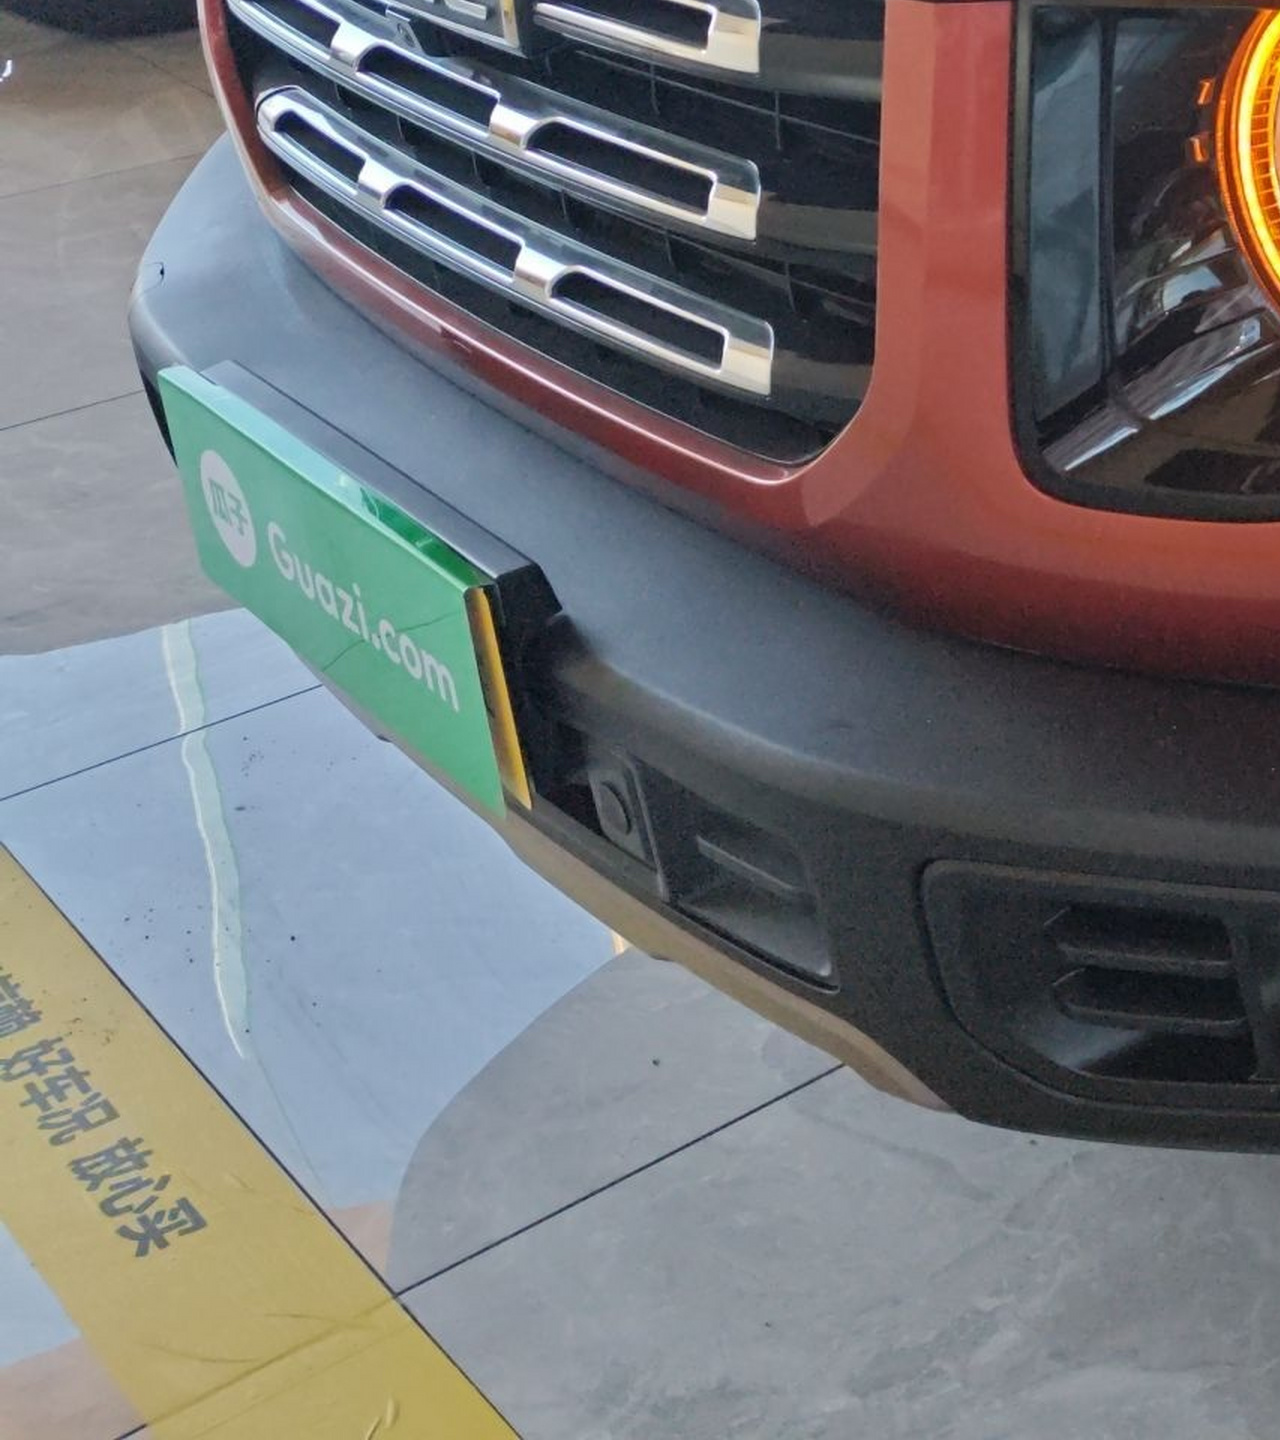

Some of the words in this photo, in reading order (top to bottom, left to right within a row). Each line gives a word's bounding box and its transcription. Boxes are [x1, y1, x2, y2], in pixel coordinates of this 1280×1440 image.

[267, 521, 459, 713] Guazi.com
[0, 1036, 120, 1147] 好车况
[67, 1136, 208, 1258] 放心买
